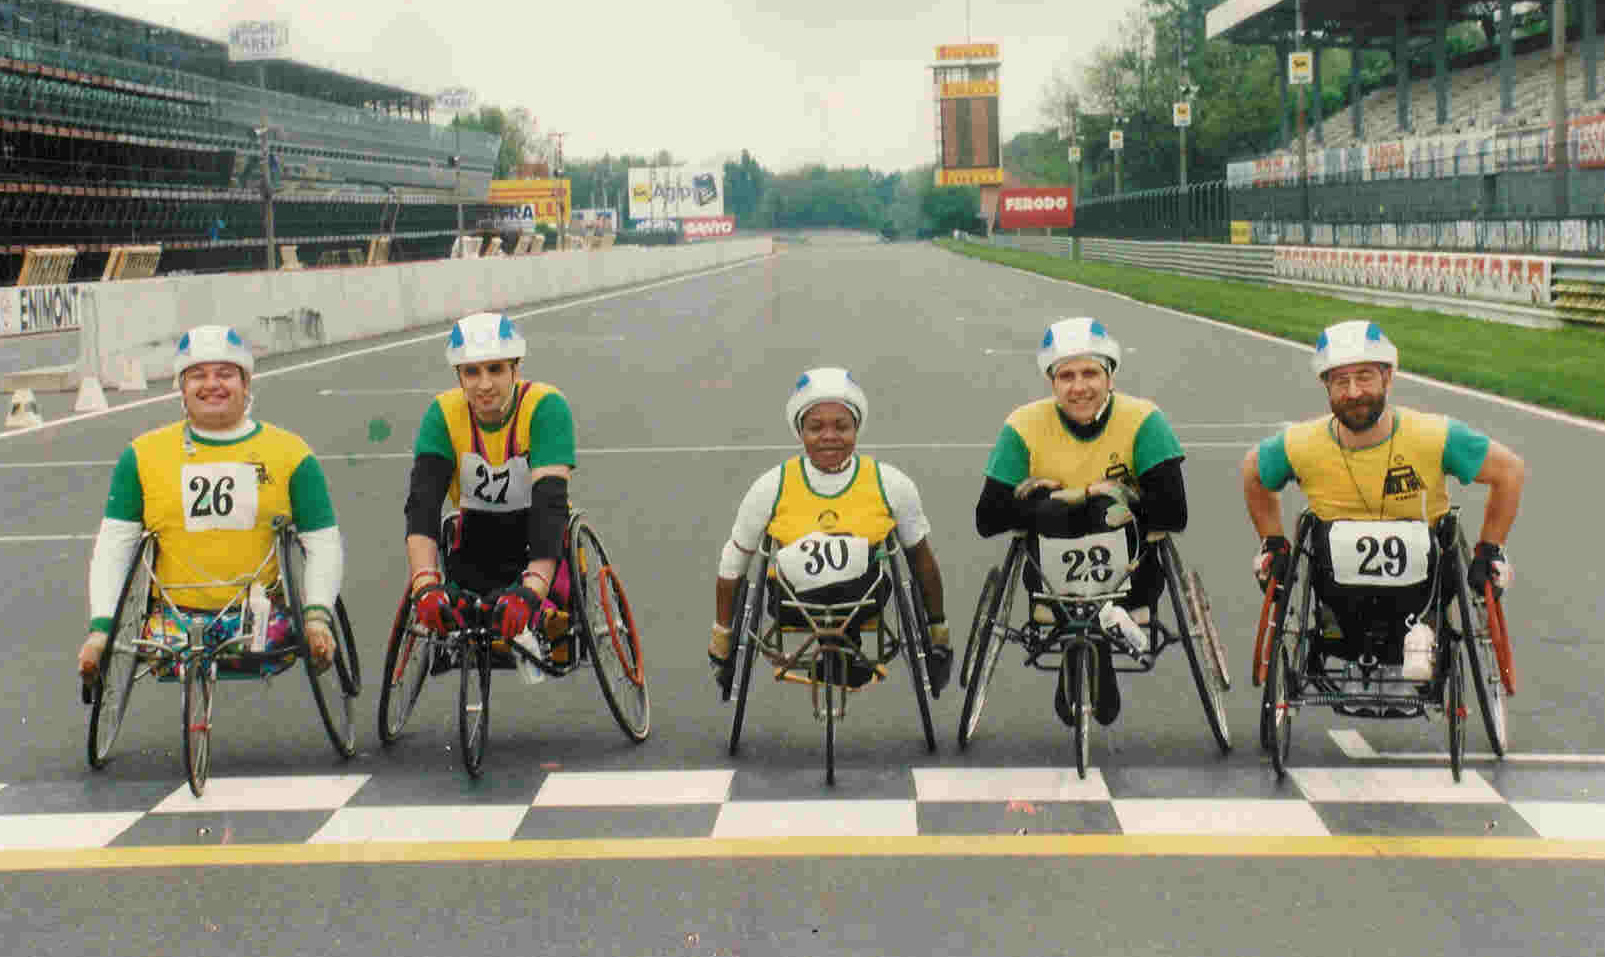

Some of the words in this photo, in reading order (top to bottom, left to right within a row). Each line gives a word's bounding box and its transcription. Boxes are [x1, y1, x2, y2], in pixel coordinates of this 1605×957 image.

[1004, 195, 1068, 211] FERODO
[189, 476, 235, 517] 26
[474, 464, 509, 504] 27
[800, 538, 849, 575] 30
[1061, 546, 1113, 582] 28
[1356, 536, 1407, 577] 29
